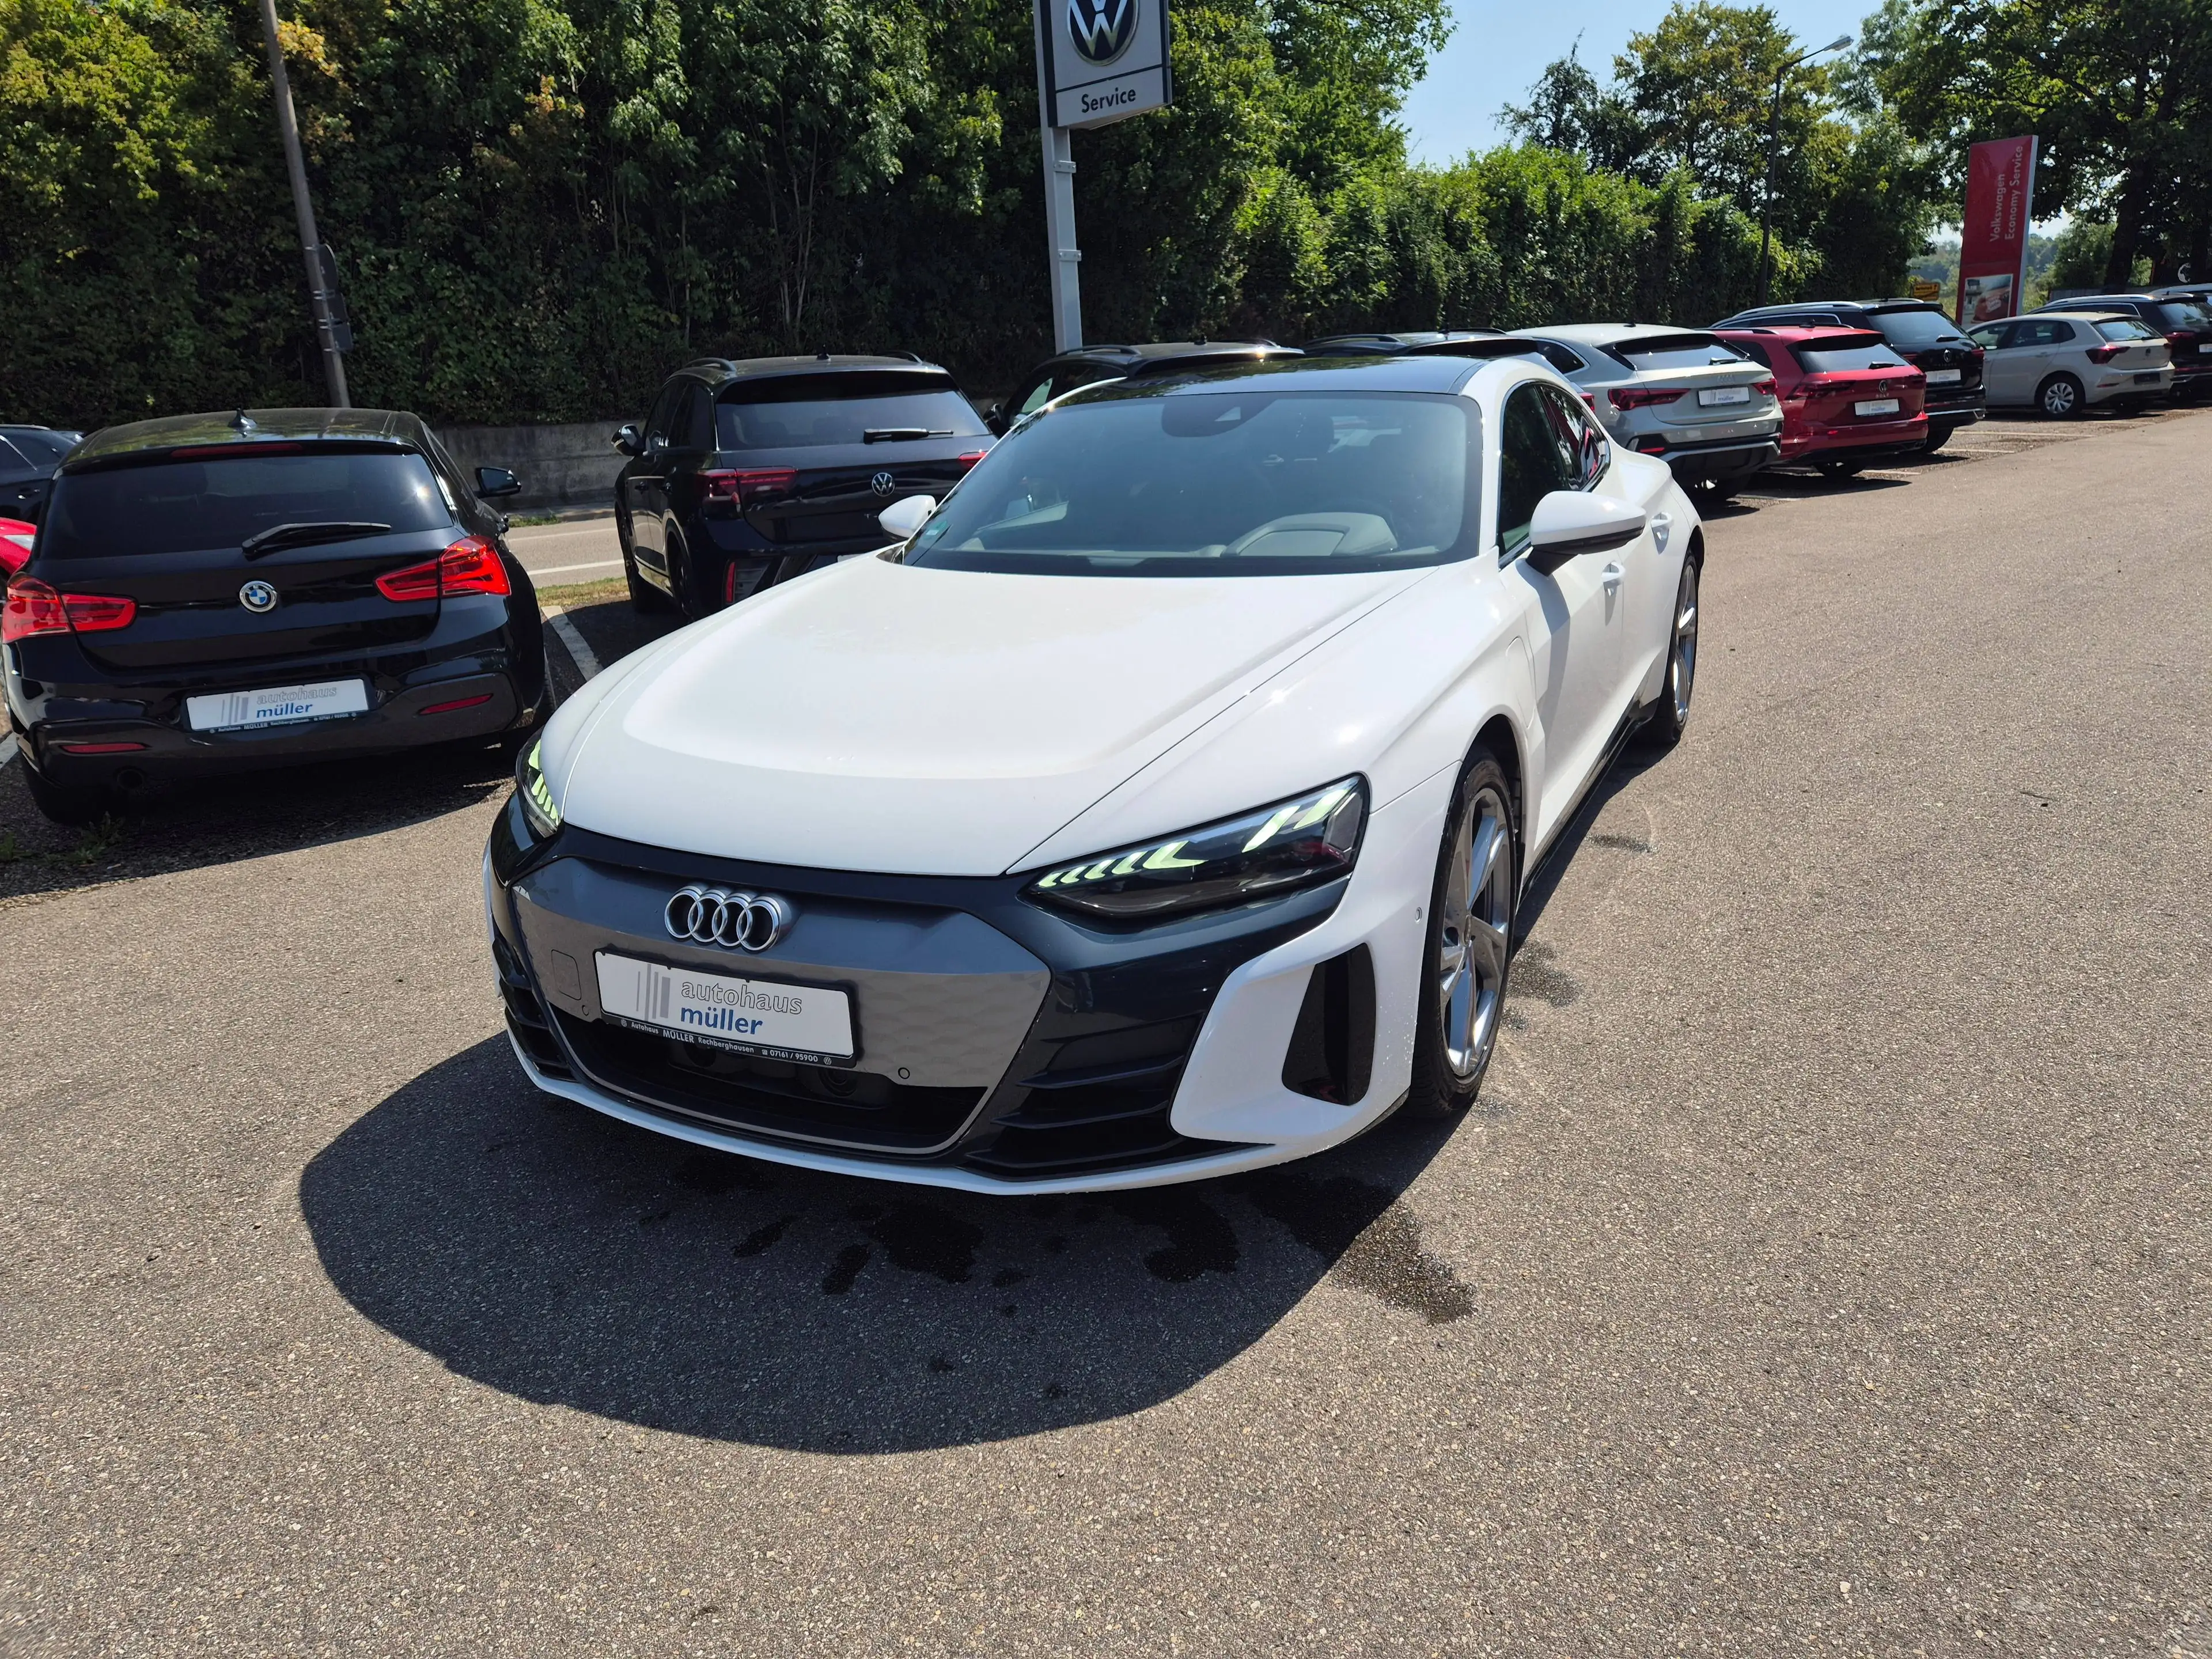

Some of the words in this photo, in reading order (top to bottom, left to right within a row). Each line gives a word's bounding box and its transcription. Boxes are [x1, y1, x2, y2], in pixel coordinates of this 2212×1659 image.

[1081, 88, 1136, 113] Service
[2009, 146, 2023, 186] Service
[1990, 174, 2006, 242] Volkswagen
[2005, 190, 2021, 240] Economy
[256, 703, 313, 718] müller
[257, 686, 337, 704] autohaus
[681, 982, 802, 1015] autohaus
[680, 1006, 763, 1035] müller
[631, 1021, 659, 1034] Autohaus
[698, 1037, 754, 1054] Rechberghausen
[770, 1050, 788, 1059] 07161
[795, 1053, 818, 1062] 95900
